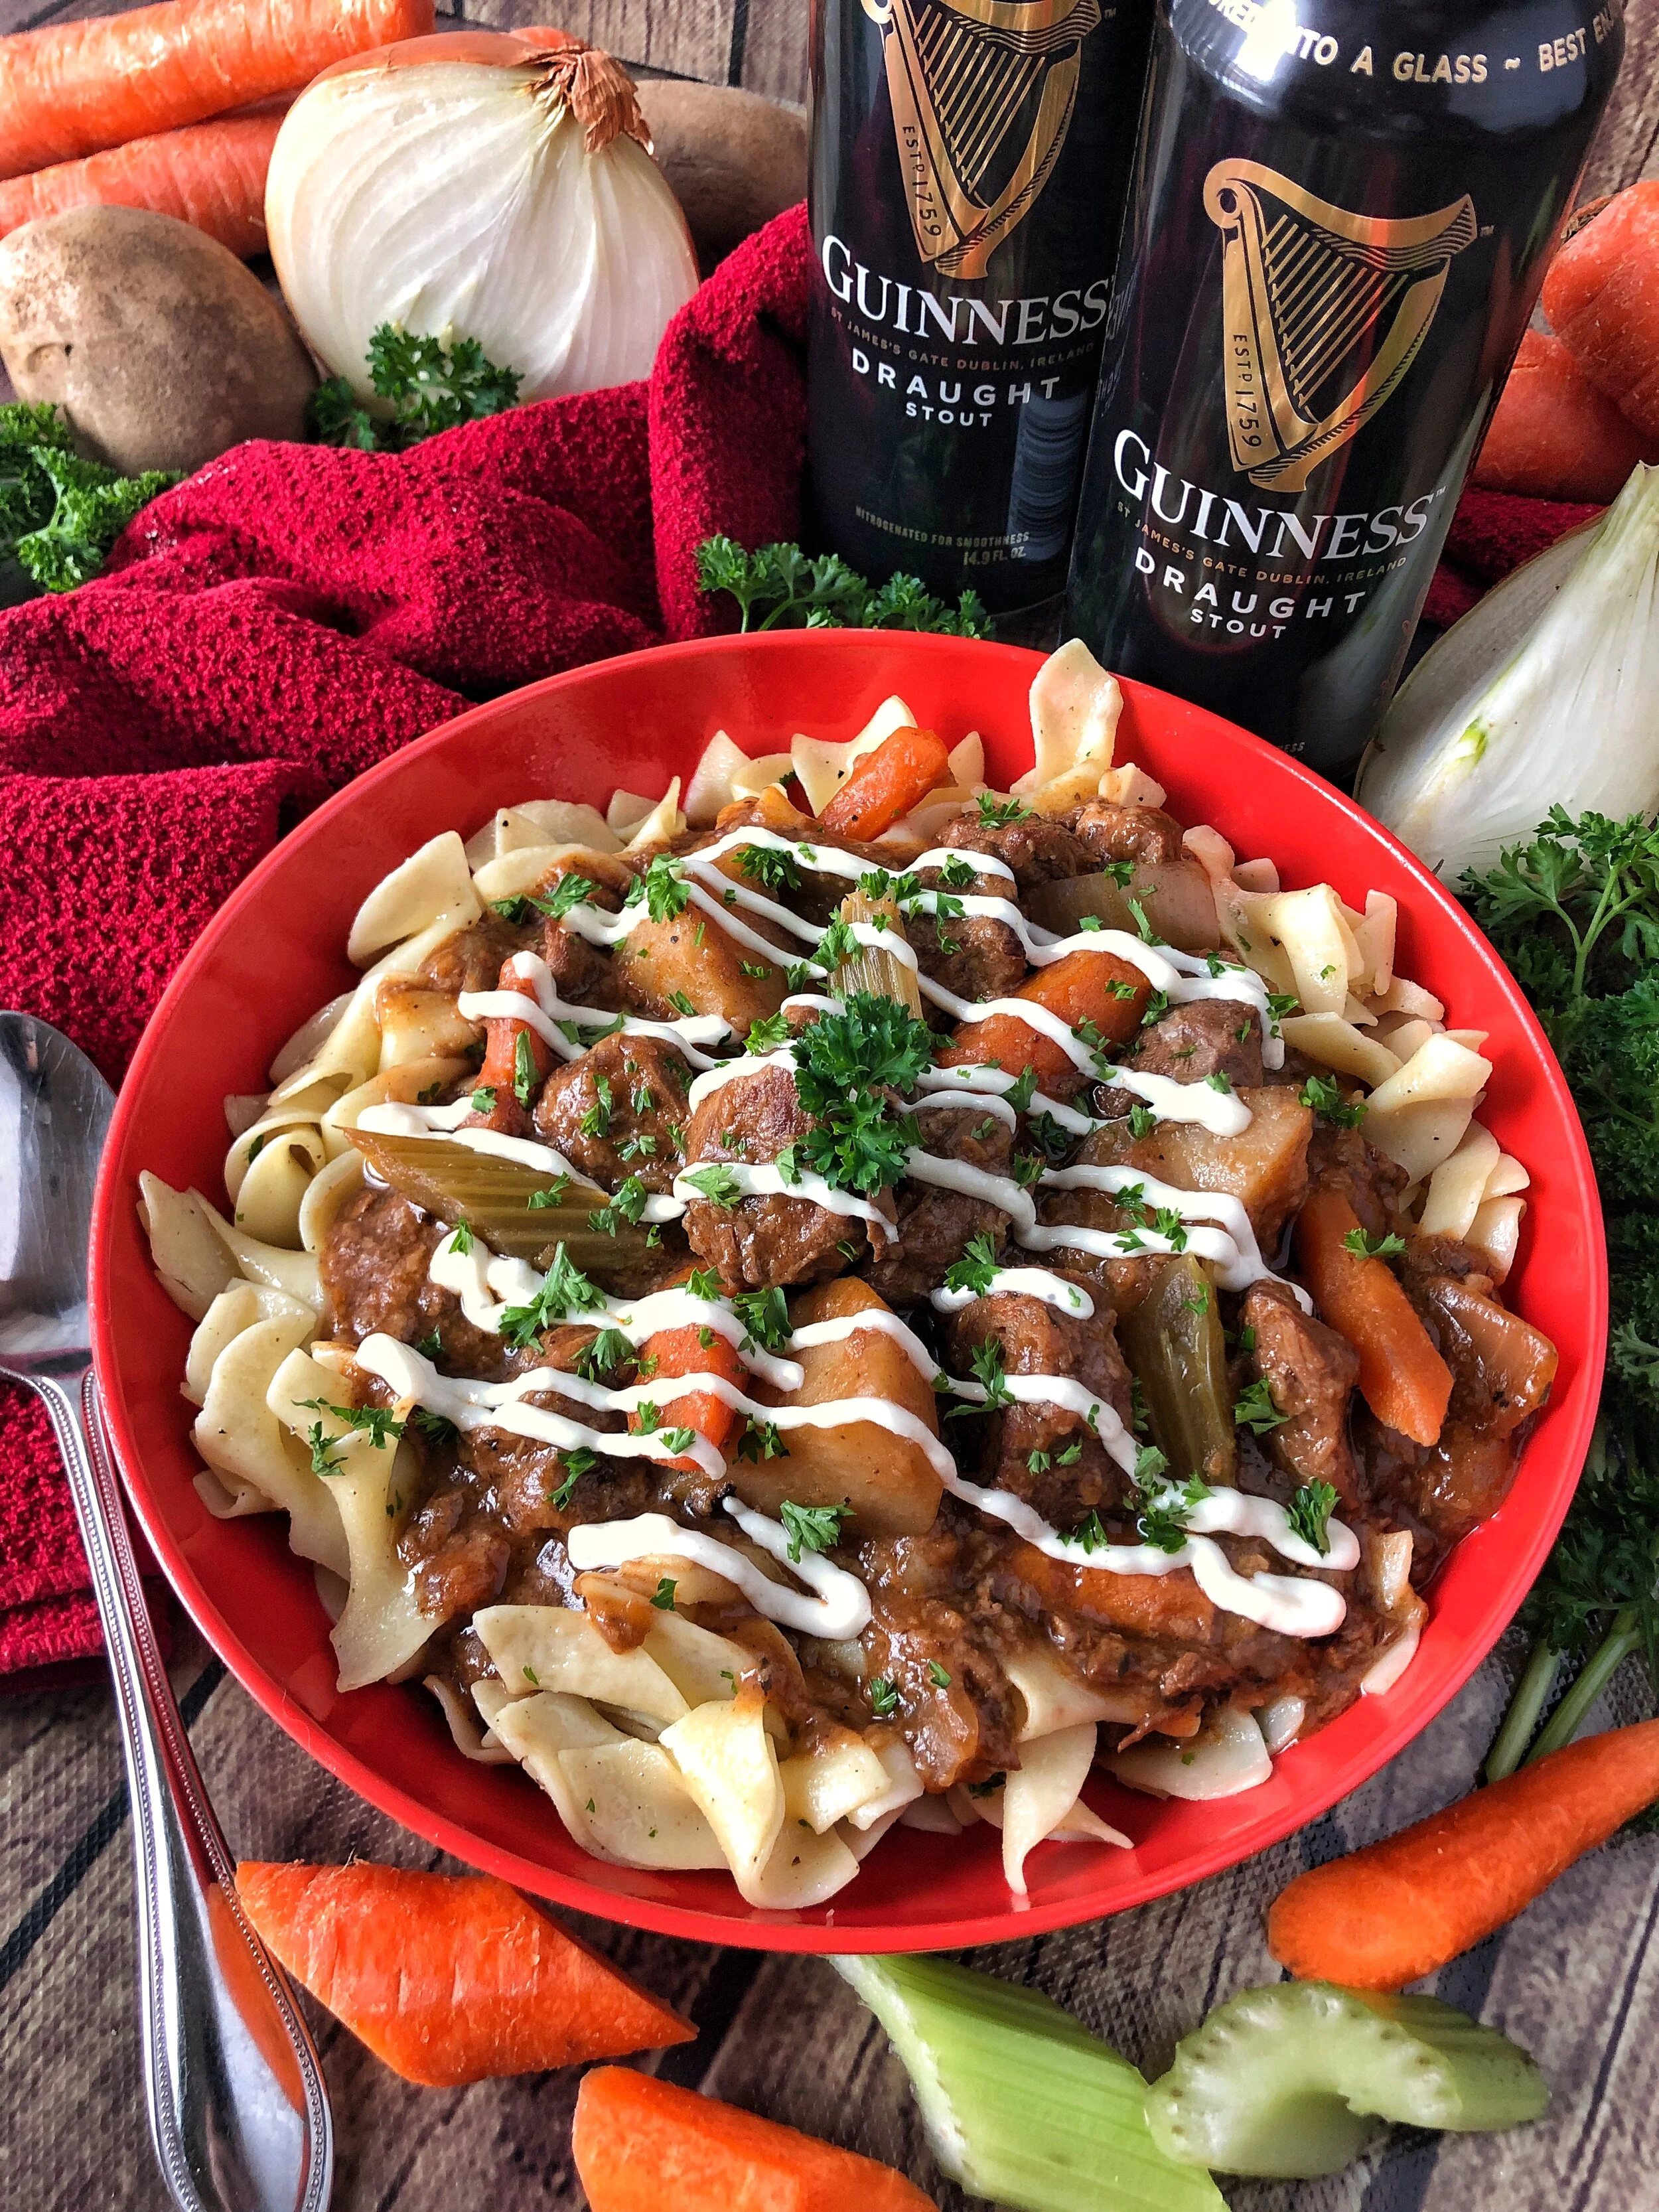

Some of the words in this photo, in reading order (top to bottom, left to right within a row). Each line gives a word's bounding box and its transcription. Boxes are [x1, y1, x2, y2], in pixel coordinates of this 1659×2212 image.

[1350, 46, 1374, 76] A
[1393, 52, 1488, 84] GLASS
[1538, 27, 1586, 72] BEST
[912, 181, 942, 237] 1759
[822, 234, 1110, 345] GUINNESS
[847, 321, 902, 355] JAMES'S
[908, 349, 948, 367] GATE
[1031, 342, 1095, 368] IRELAND
[852, 347, 1060, 406] DRAUGHT
[905, 402, 994, 427] STOUT
[1235, 390, 1262, 448] 1759
[1114, 429, 1435, 560] GUINNESS
[855, 505, 928, 543] NITROGENATED
[931, 534, 952, 546] FOR
[956, 532, 1029, 548] SMOOTHNESS
[1011, 546, 1027, 559] OZ
[1117, 501, 1130, 518] ST
[1134, 519, 1194, 560] JAMES'S
[1202, 557, 1248, 577] GATE
[1336, 557, 1406, 583] IRELAND
[1135, 547, 1366, 619] DRAUGHT
[1190, 608, 1287, 639] STOUT
